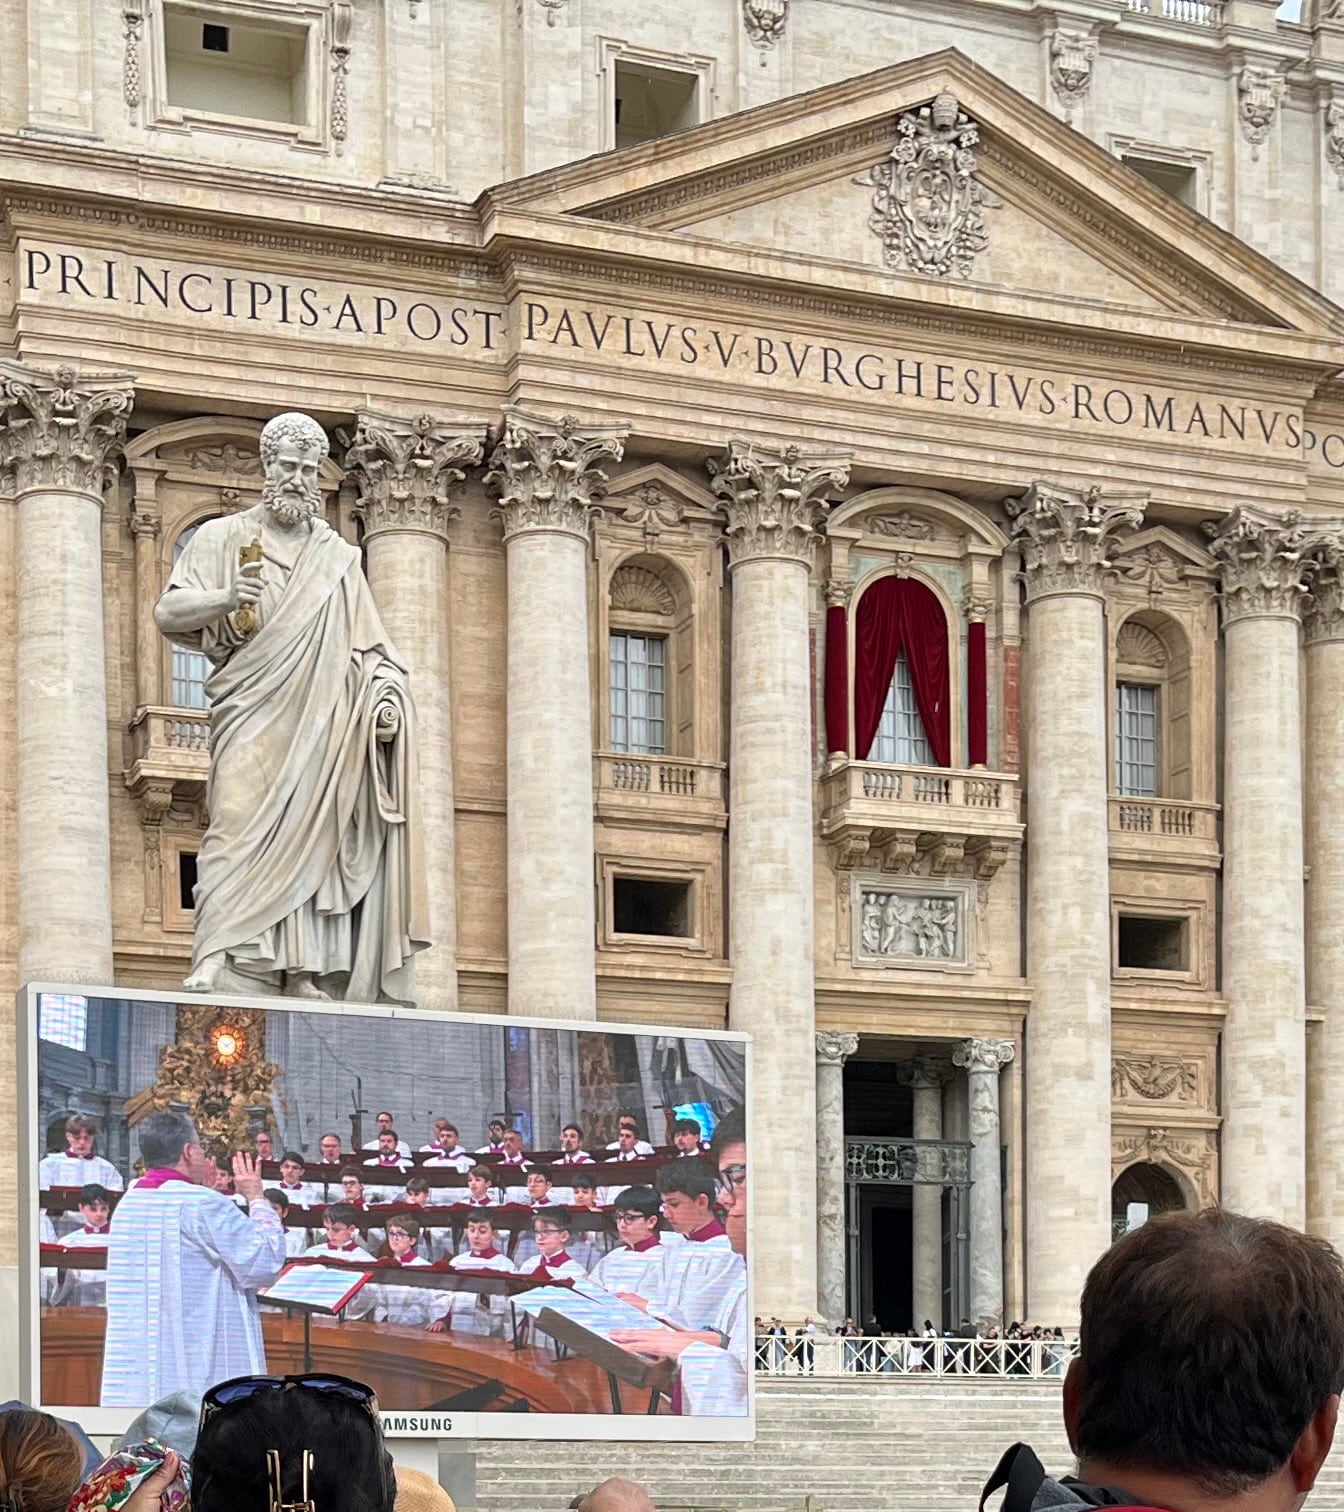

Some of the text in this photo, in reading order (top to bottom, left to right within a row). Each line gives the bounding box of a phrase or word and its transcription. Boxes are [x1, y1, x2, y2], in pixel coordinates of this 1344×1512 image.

[24, 250, 320, 326] PRINCIPIS
[332, 293, 503, 349] APOST
[523, 303, 698, 364] PAVLVS
[710, 331, 739, 368] V
[753, 337, 1057, 414] BVRGHESIVS
[1072, 382, 1301, 449] ROMANVS
[383, 1417, 453, 1431] AMSUNG
